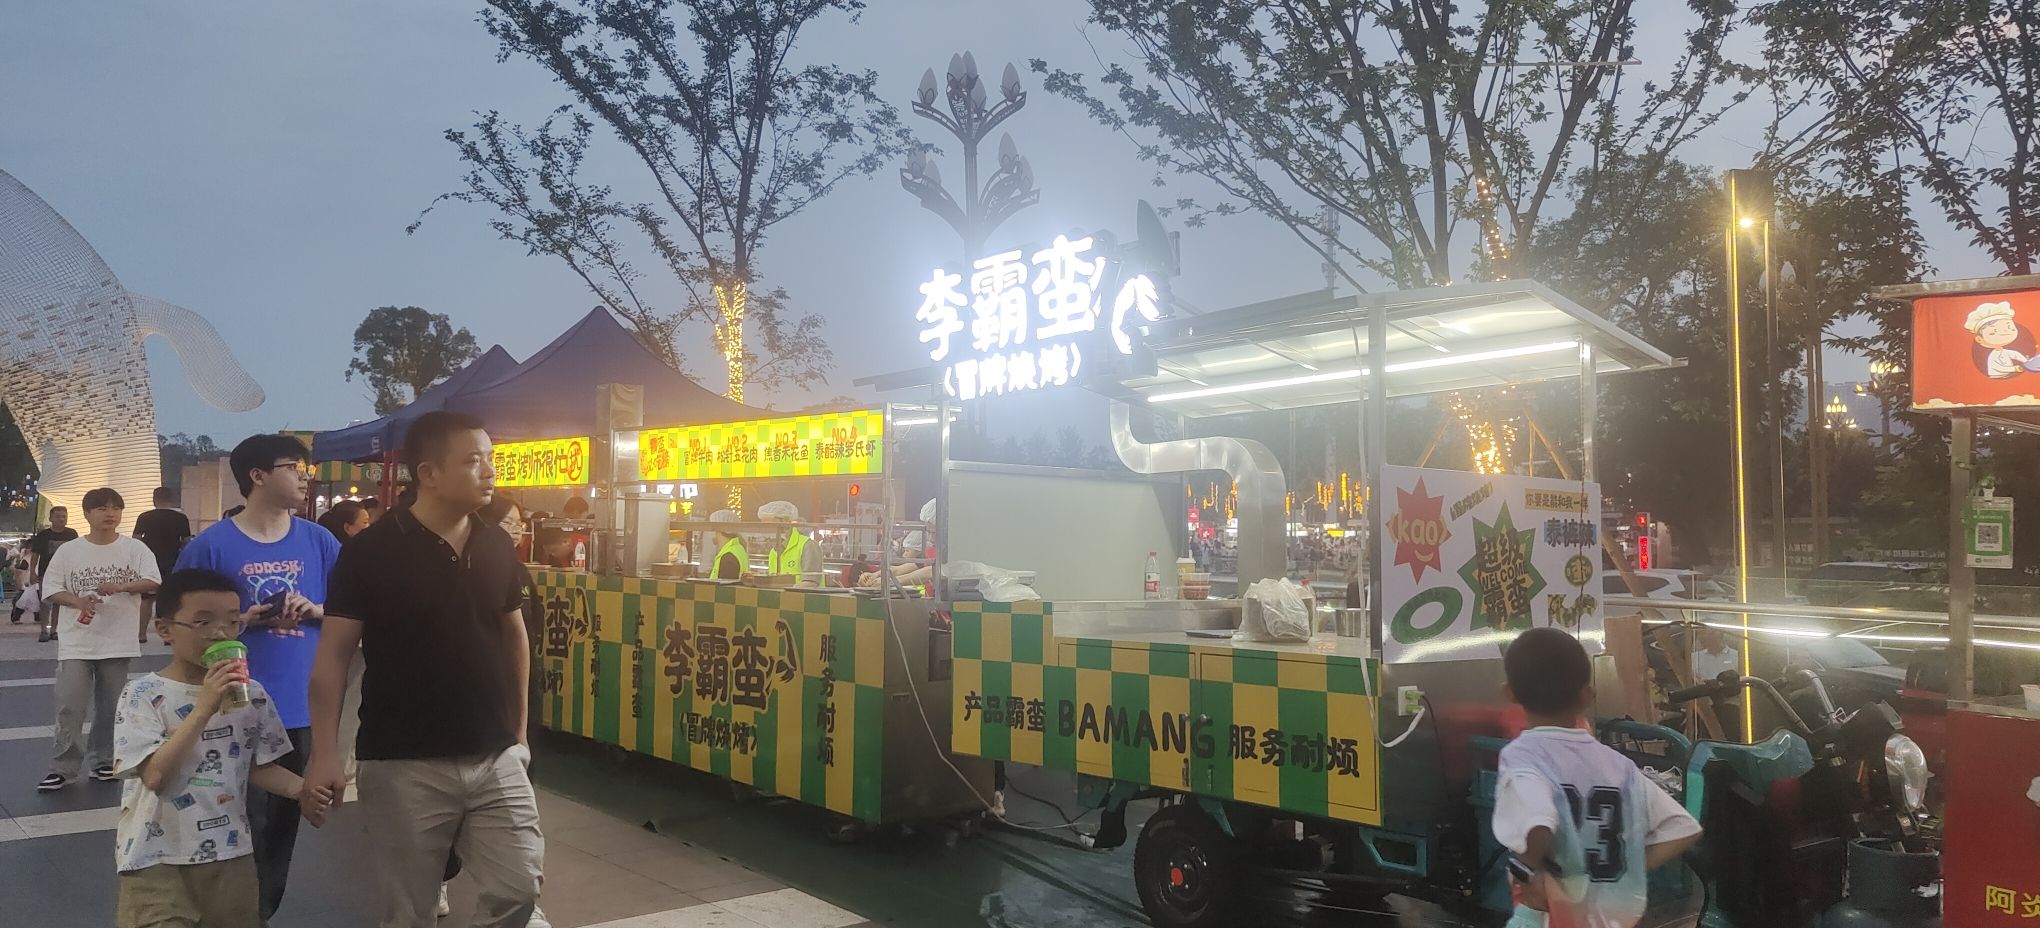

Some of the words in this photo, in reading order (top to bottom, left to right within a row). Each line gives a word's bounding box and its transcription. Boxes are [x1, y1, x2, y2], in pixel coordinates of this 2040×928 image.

[915, 234, 1096, 362] 李霸蛮
[831, 425, 859, 444] NO.4
[1525, 491, 1589, 511] 你要是能和我一样
[662, 620, 768, 711] 李霸蛮
[816, 633, 837, 768] 服务耐烦
[963, 690, 1047, 733] 产品霸蛮
[1058, 699, 1216, 760] BAMANG
[1227, 723, 1361, 779] 服务耐烦
